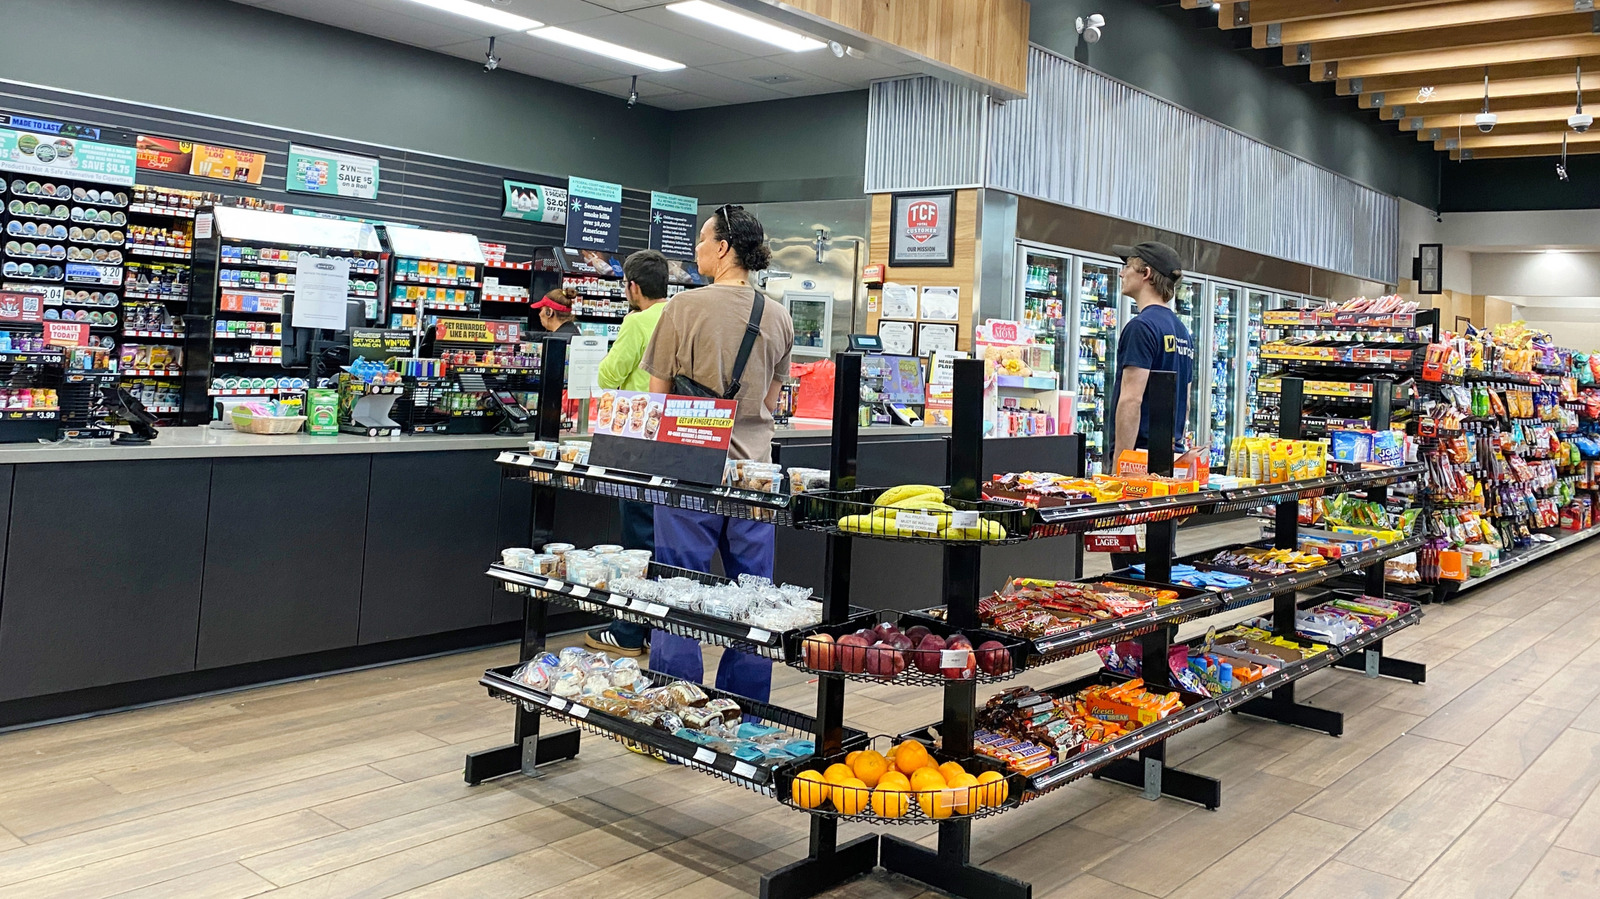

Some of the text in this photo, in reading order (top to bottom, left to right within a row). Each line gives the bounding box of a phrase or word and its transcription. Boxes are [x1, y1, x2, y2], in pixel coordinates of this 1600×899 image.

[12, 118, 31, 127] MADE
[34, 121, 42, 129] TO
[43, 123, 60, 132] LAST
[205, 145, 224, 153] SAVE
[235, 150, 254, 158] SAVE
[82, 159, 105, 171] SAVE
[106, 161, 130, 174] $4.75
[340, 164, 357, 173] ZYN
[65, 168, 94, 178] Alternative
[338, 173, 373, 185] SAVE $5
[584, 202, 613, 213] Secondhand
[583, 211, 610, 220] smoke kills
[910, 204, 936, 222] TCF
[594, 220, 611, 229] 38,000
[582, 227, 608, 236] Americans
[52, 324, 79, 332] DONATE
[445, 322, 487, 332] GET REWARDED
[53, 332, 78, 340] TODAY!
[449, 330, 462, 338] LIKE
[468, 332, 488, 340] FREAK.
[994, 328, 1015, 339] MOM
[384, 339, 396, 348] WIN
[43, 355, 62, 363] $3.99
[666, 399, 716, 410] WHY THE
[37, 411, 56, 420] $3.99
[694, 418, 713, 426] FINGERZ
[1095, 538, 1120, 547] LAGER
